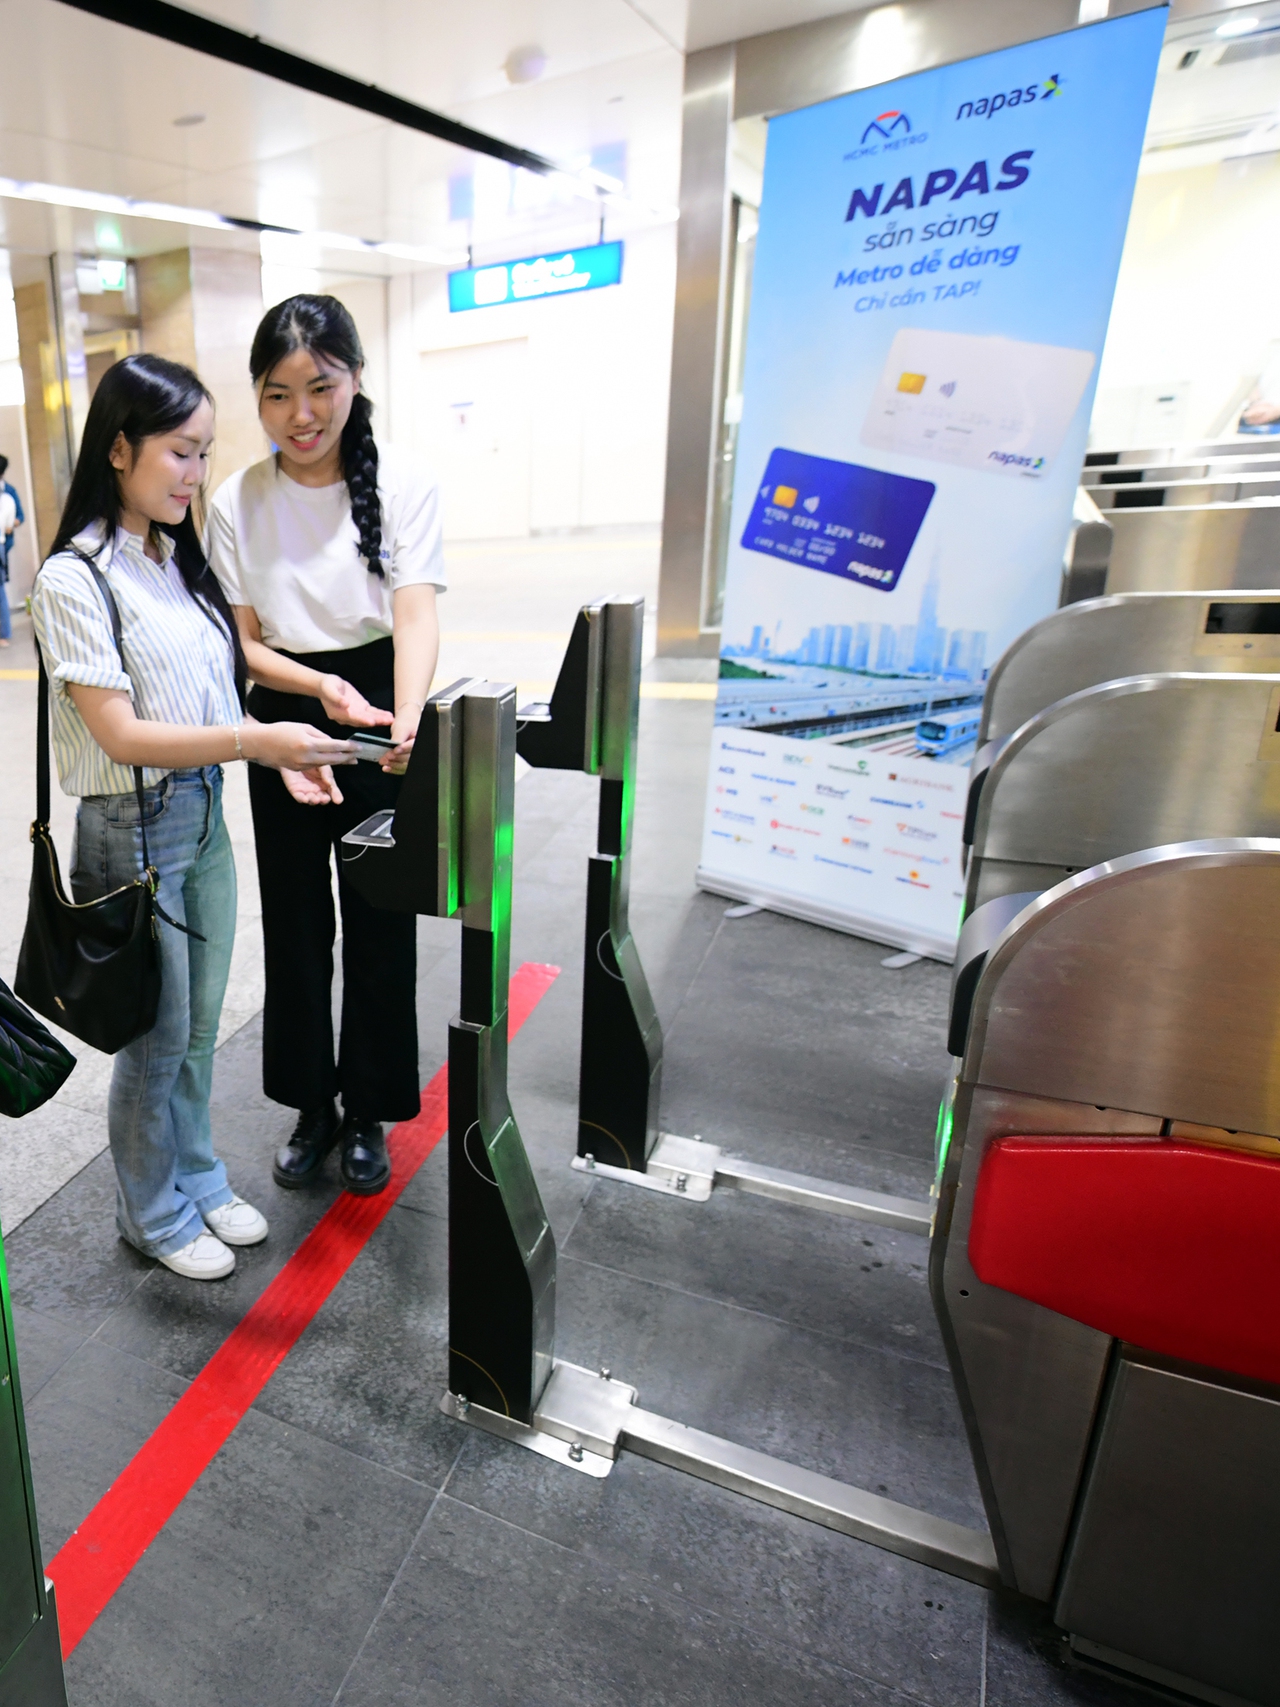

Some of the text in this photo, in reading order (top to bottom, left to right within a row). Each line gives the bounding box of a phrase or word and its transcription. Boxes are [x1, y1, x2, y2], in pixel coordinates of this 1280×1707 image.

[956, 83, 1038, 121] napas
[842, 132, 929, 162] HCMC METRO
[844, 149, 1034, 223] NAPAS
[863, 211, 1000, 252] sẵn sàng
[833, 244, 1021, 289] Metro dễ dàng
[933, 279, 982, 302] TAP!
[987, 450, 1032, 467] napas
[846, 560, 885, 580] napas
